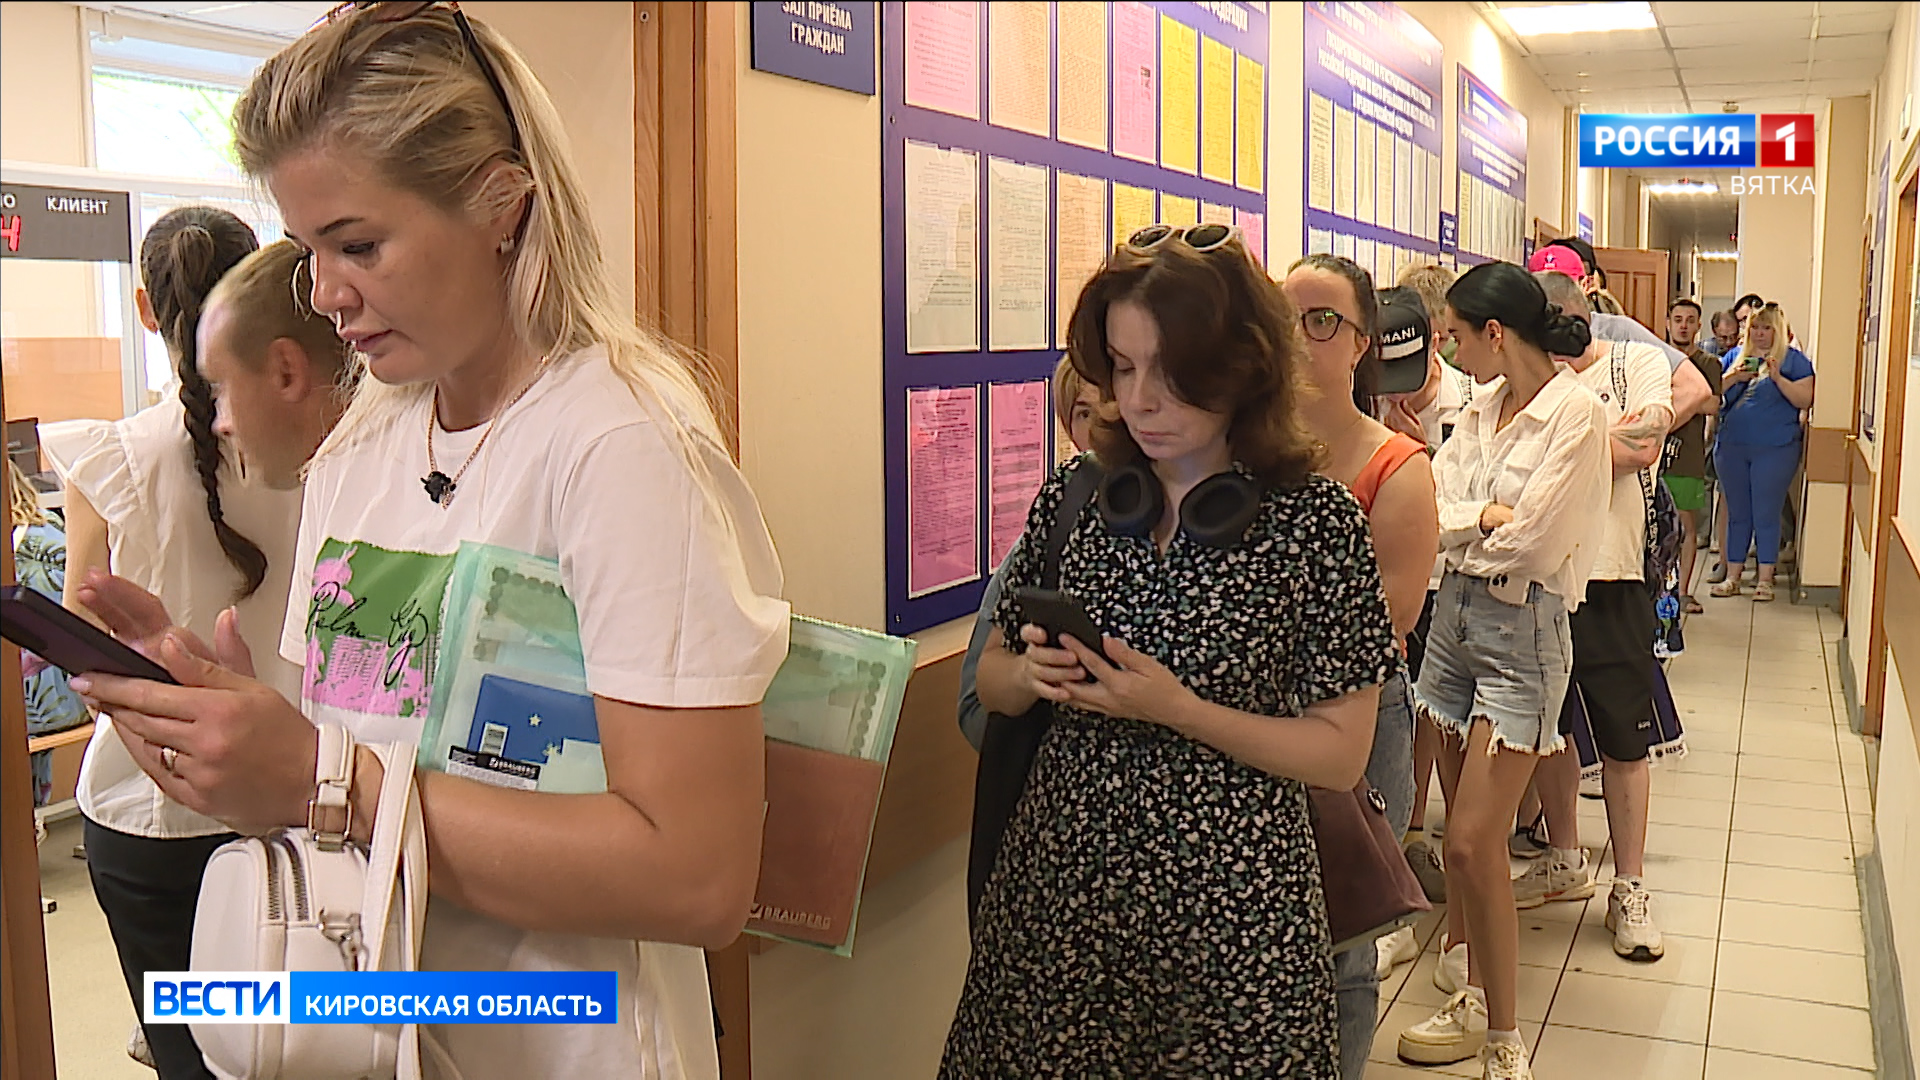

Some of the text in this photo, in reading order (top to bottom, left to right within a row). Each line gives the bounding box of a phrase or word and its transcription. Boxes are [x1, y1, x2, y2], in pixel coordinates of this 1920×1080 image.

[782, 1, 853, 31] ЗАЛ ПРИЁМА
[791, 21, 845, 54] ГРАЖДАН
[47, 196, 108, 214] КЛИЕНТ
